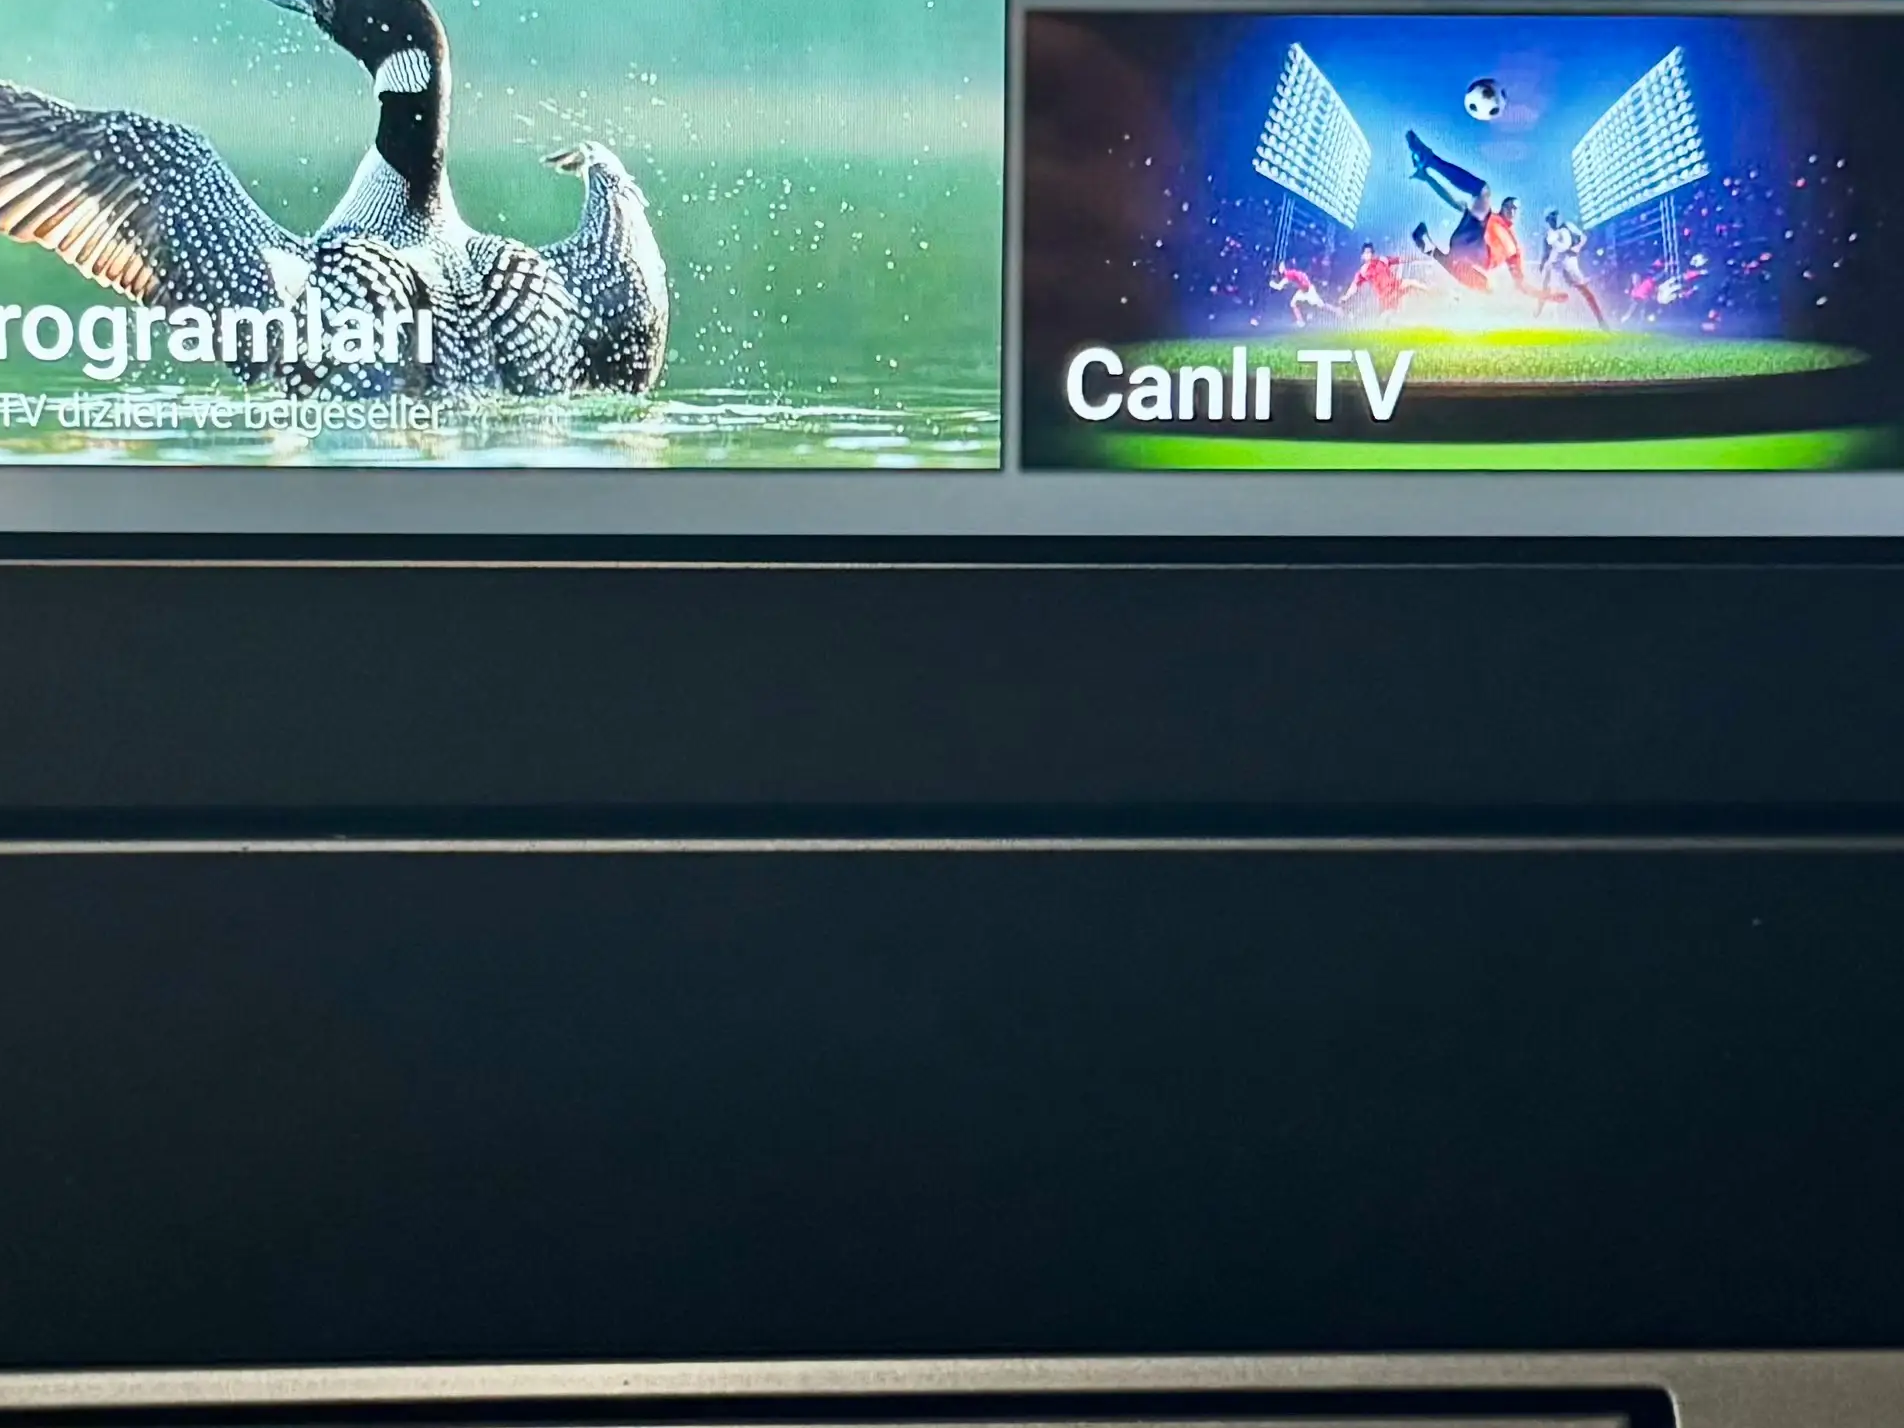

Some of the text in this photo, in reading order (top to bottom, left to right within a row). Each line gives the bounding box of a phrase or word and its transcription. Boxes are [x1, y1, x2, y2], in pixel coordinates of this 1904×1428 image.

[57, 390, 178, 430] dizileri
[189, 401, 235, 430] ve
[244, 392, 447, 440] belgeseller
[1065, 346, 1414, 424] Canlı TV
